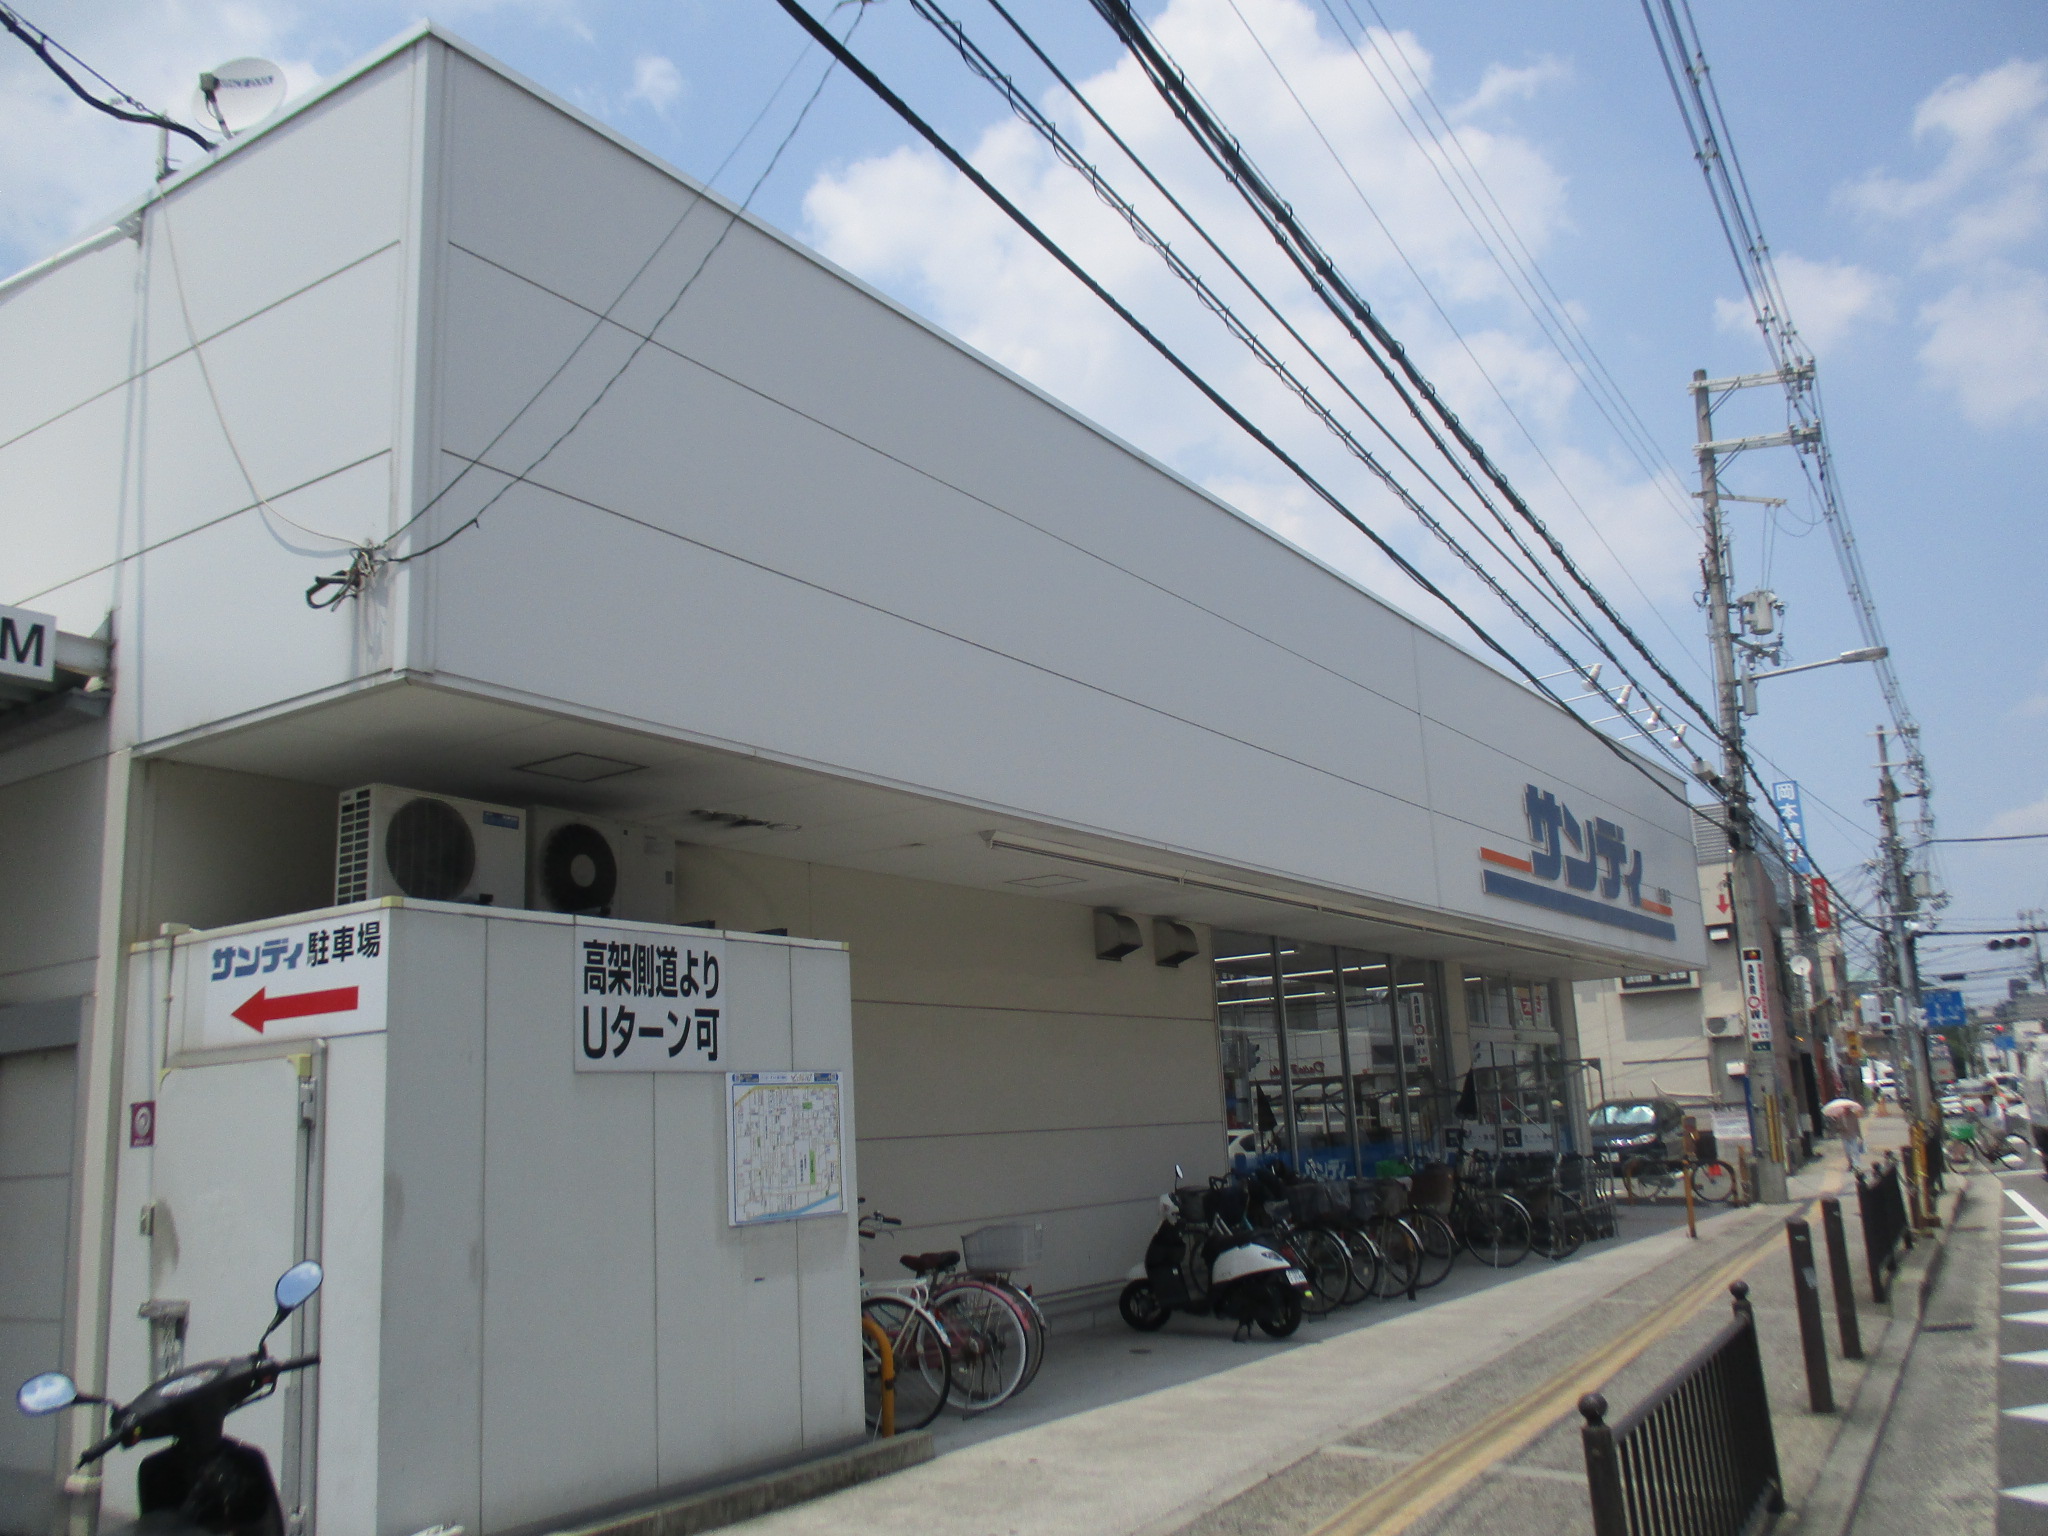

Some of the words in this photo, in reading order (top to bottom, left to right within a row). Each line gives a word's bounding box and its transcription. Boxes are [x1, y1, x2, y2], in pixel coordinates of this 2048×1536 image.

[1523, 783, 1643, 907] サンディ
[211, 921, 381, 982] サンディ駐車場
[583, 939, 720, 999] 高架側道より
[583, 1005, 720, 1062] Uターン可
